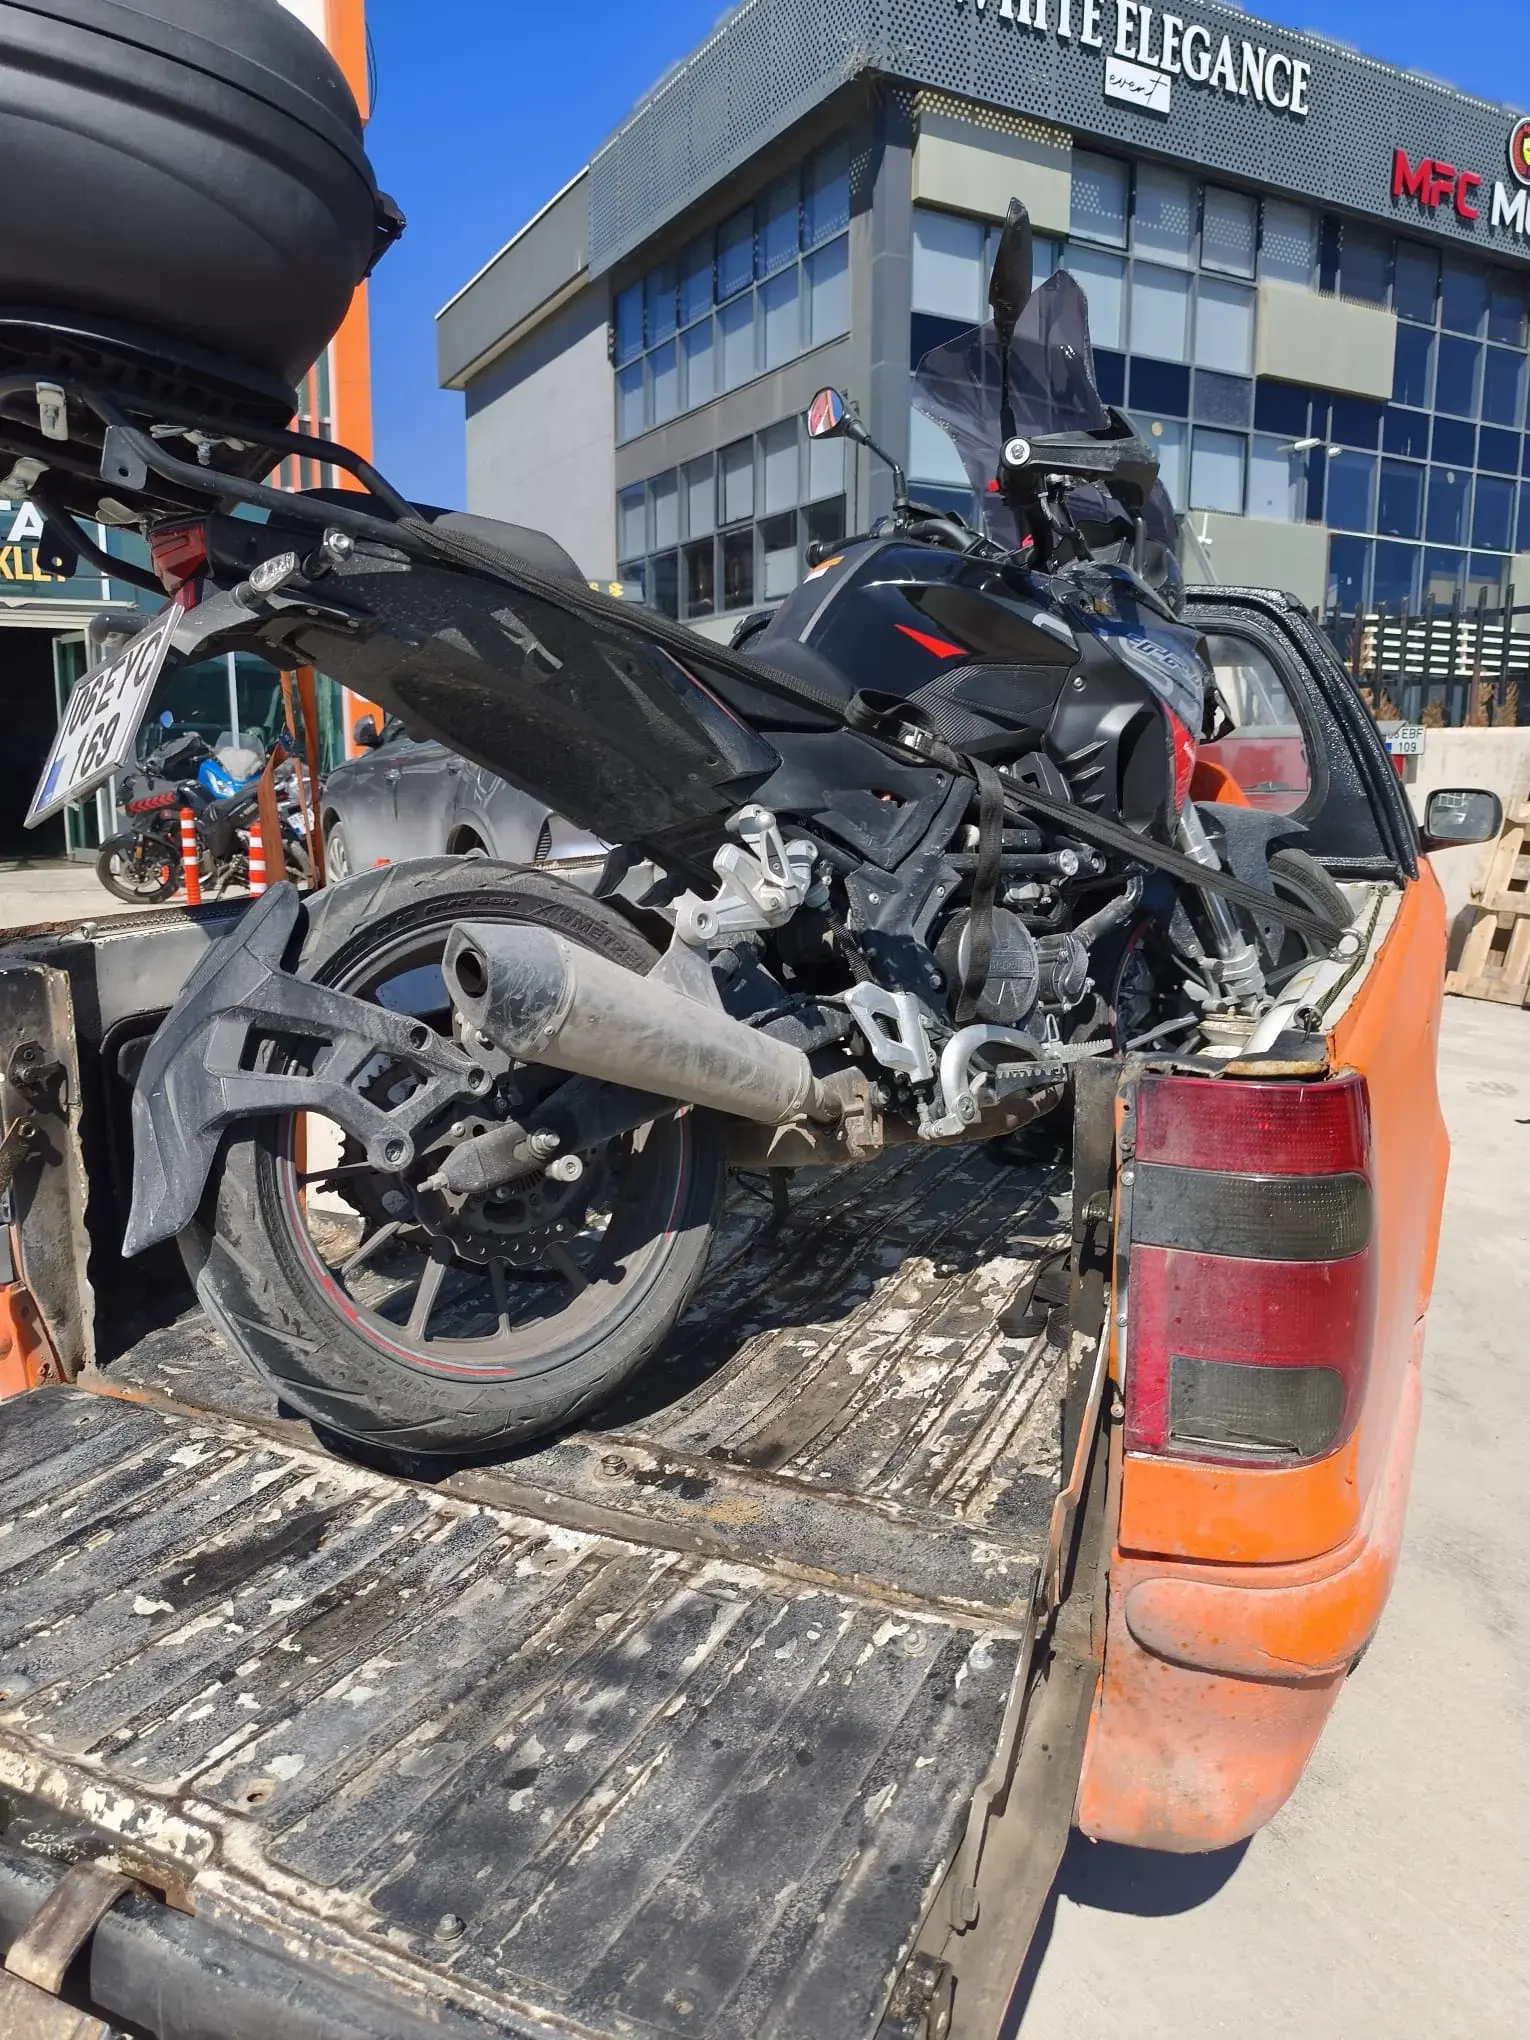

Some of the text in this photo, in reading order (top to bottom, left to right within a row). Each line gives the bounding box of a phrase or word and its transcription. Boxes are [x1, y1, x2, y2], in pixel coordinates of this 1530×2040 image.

[1108, 73, 1168, 105] event
[1115, 0, 1311, 116] ELEGANCE
[1392, 147, 1481, 221] MFC
[1490, 181, 1530, 236] M
[68, 712, 121, 786] 169
[1399, 742, 1417, 753] 109
